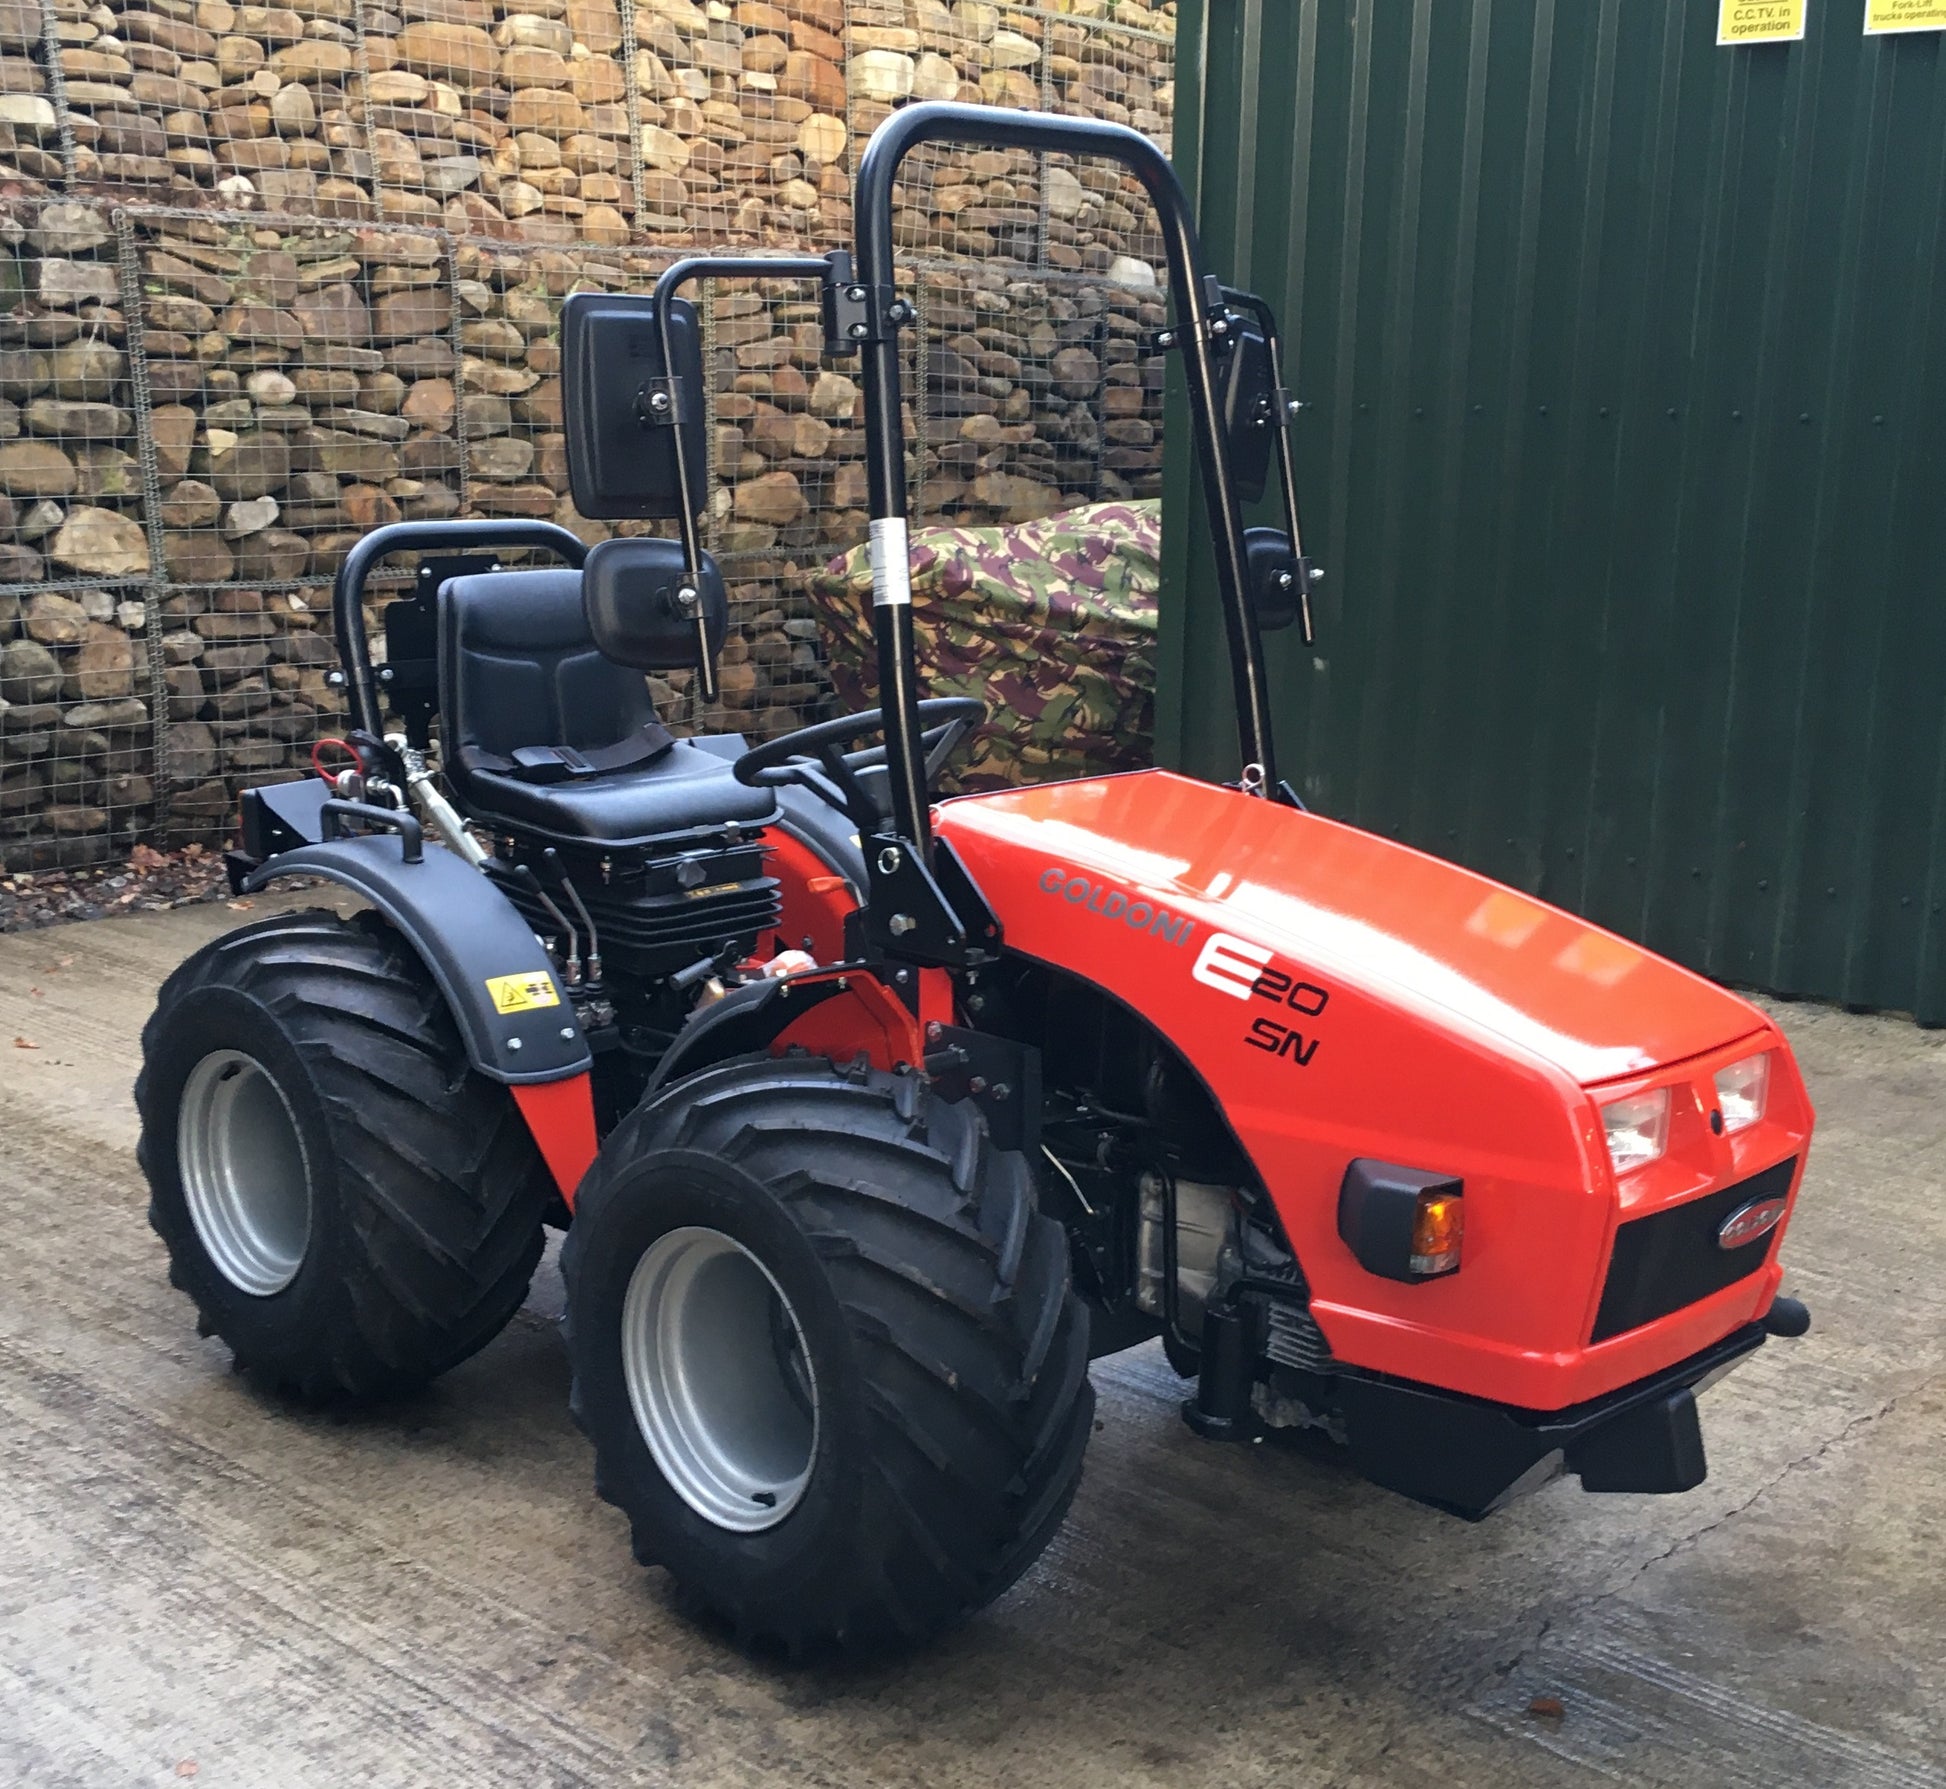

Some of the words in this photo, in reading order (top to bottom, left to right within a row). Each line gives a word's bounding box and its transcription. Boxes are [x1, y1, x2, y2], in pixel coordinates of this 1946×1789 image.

[1779, 6, 1791, 17] in
[1872, 11, 1903, 22] trucks
[1731, 20, 1791, 36] operation
[1039, 867, 1196, 947] GOLDONI
[1243, 1017, 1321, 1067] SN
